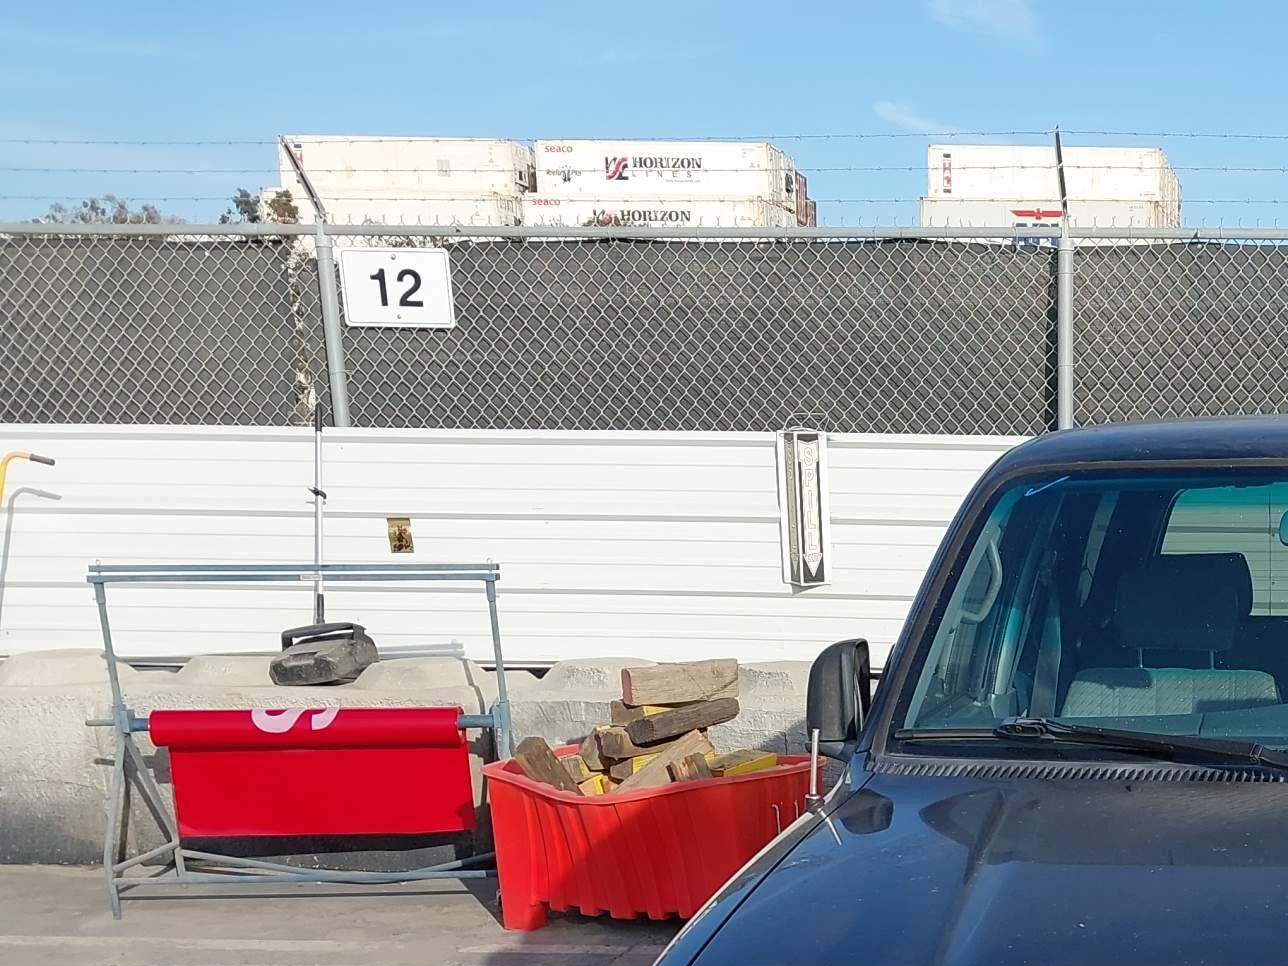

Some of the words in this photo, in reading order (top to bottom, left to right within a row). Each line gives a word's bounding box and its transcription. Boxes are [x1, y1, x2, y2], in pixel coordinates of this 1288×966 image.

[544, 145, 573, 153] seaco
[632, 157, 702, 169] HORIZON
[632, 170, 693, 178] LINES
[532, 198, 561, 206] seaco
[620, 210, 691, 222] HORIZON
[370, 268, 424, 307] 12
[803, 446, 817, 551] SPILL
